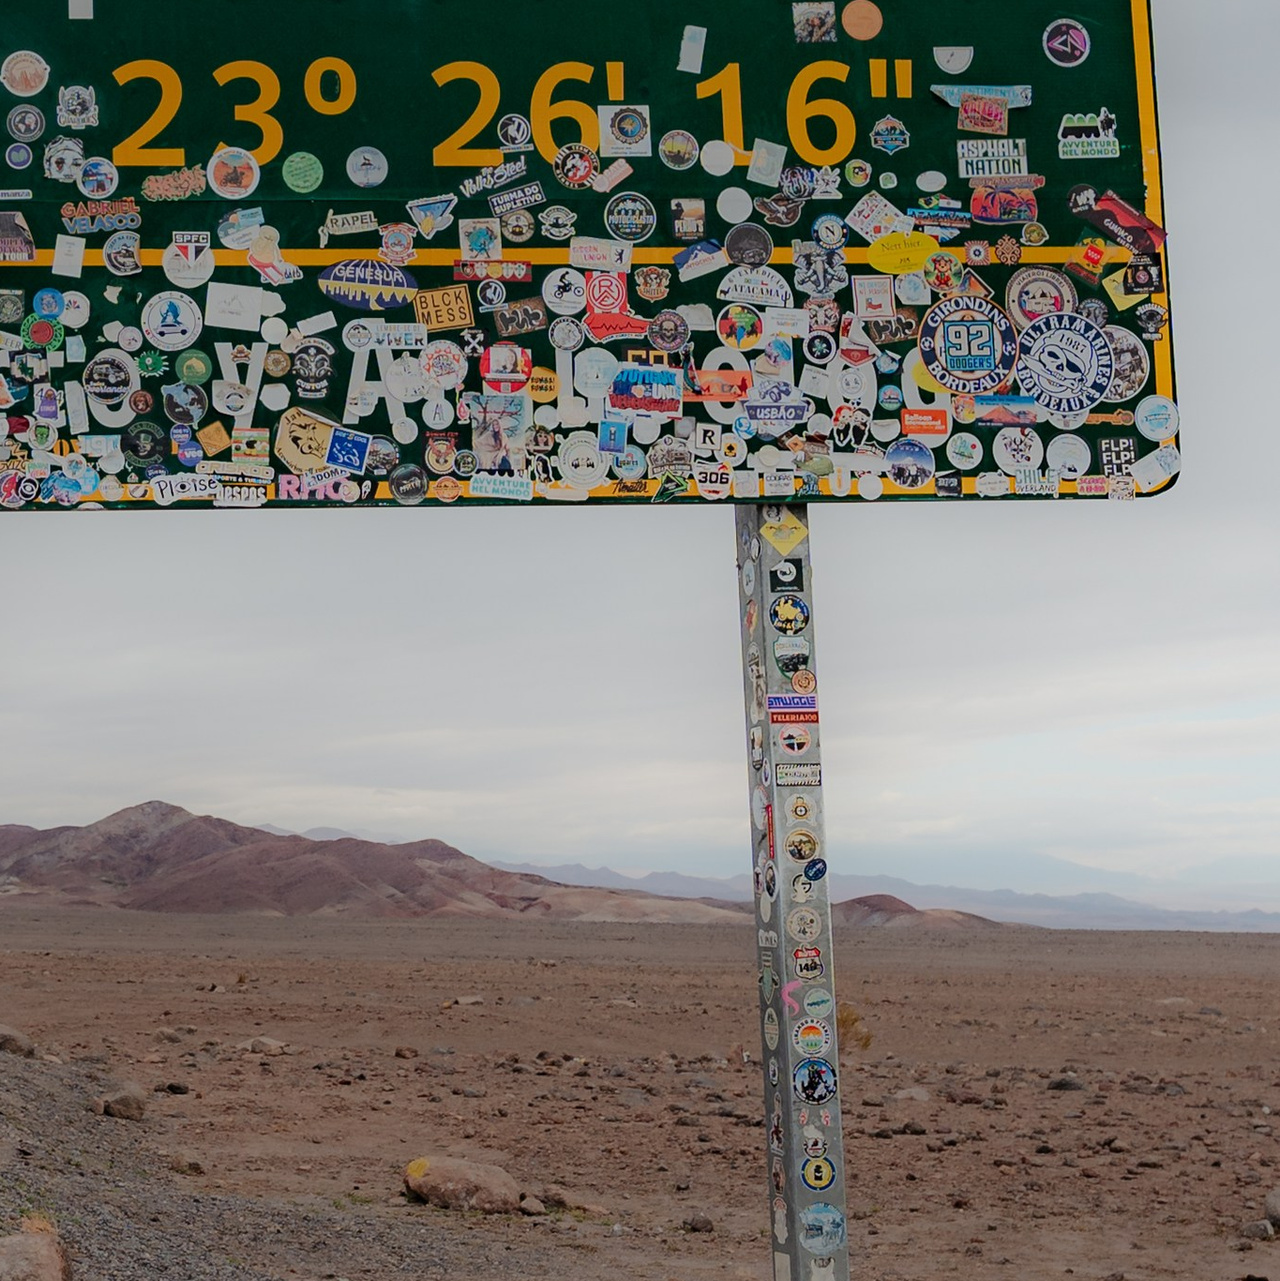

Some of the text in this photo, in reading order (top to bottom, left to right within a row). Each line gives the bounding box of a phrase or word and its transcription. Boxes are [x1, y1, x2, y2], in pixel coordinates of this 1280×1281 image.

[957, 139, 1026, 158] ASPHALT
[1062, 140, 1117, 149] AVVENTURE
[1081, 148, 1117, 156] MONDO
[965, 159, 1021, 175] NATION
[491, 185, 539, 205] TURMA DO
[61, 200, 139, 218] GABRIEL
[494, 193, 542, 215] SUPLETIVO
[61, 212, 142, 234] VELASCO
[175, 234, 207, 243] SPFC
[335, 266, 403, 283] GENESUR
[732, 283, 779, 297] ATACAMA
[420, 290, 462, 310] BLCK
[421, 306, 468, 326] MESS
[926, 295, 1011, 332] GIRONDINS
[947, 325, 992, 357] 92
[1059, 334, 1086, 353] 1987
[1021, 315, 1112, 387] ULTRAMARINES
[927, 363, 1011, 393] BORDEAUX
[1017, 362, 1090, 412] BORDEAUX
[1101, 439, 1134, 451] FLP!
[1102, 450, 1135, 464] FLP!
[473, 476, 531, 488] AVVENTURE
[698, 472, 730, 484] 306
[1015, 469, 1056, 484] CHILE
[495, 487, 530, 497] MONDO
[767, 696, 816, 706] SMUGGLE
